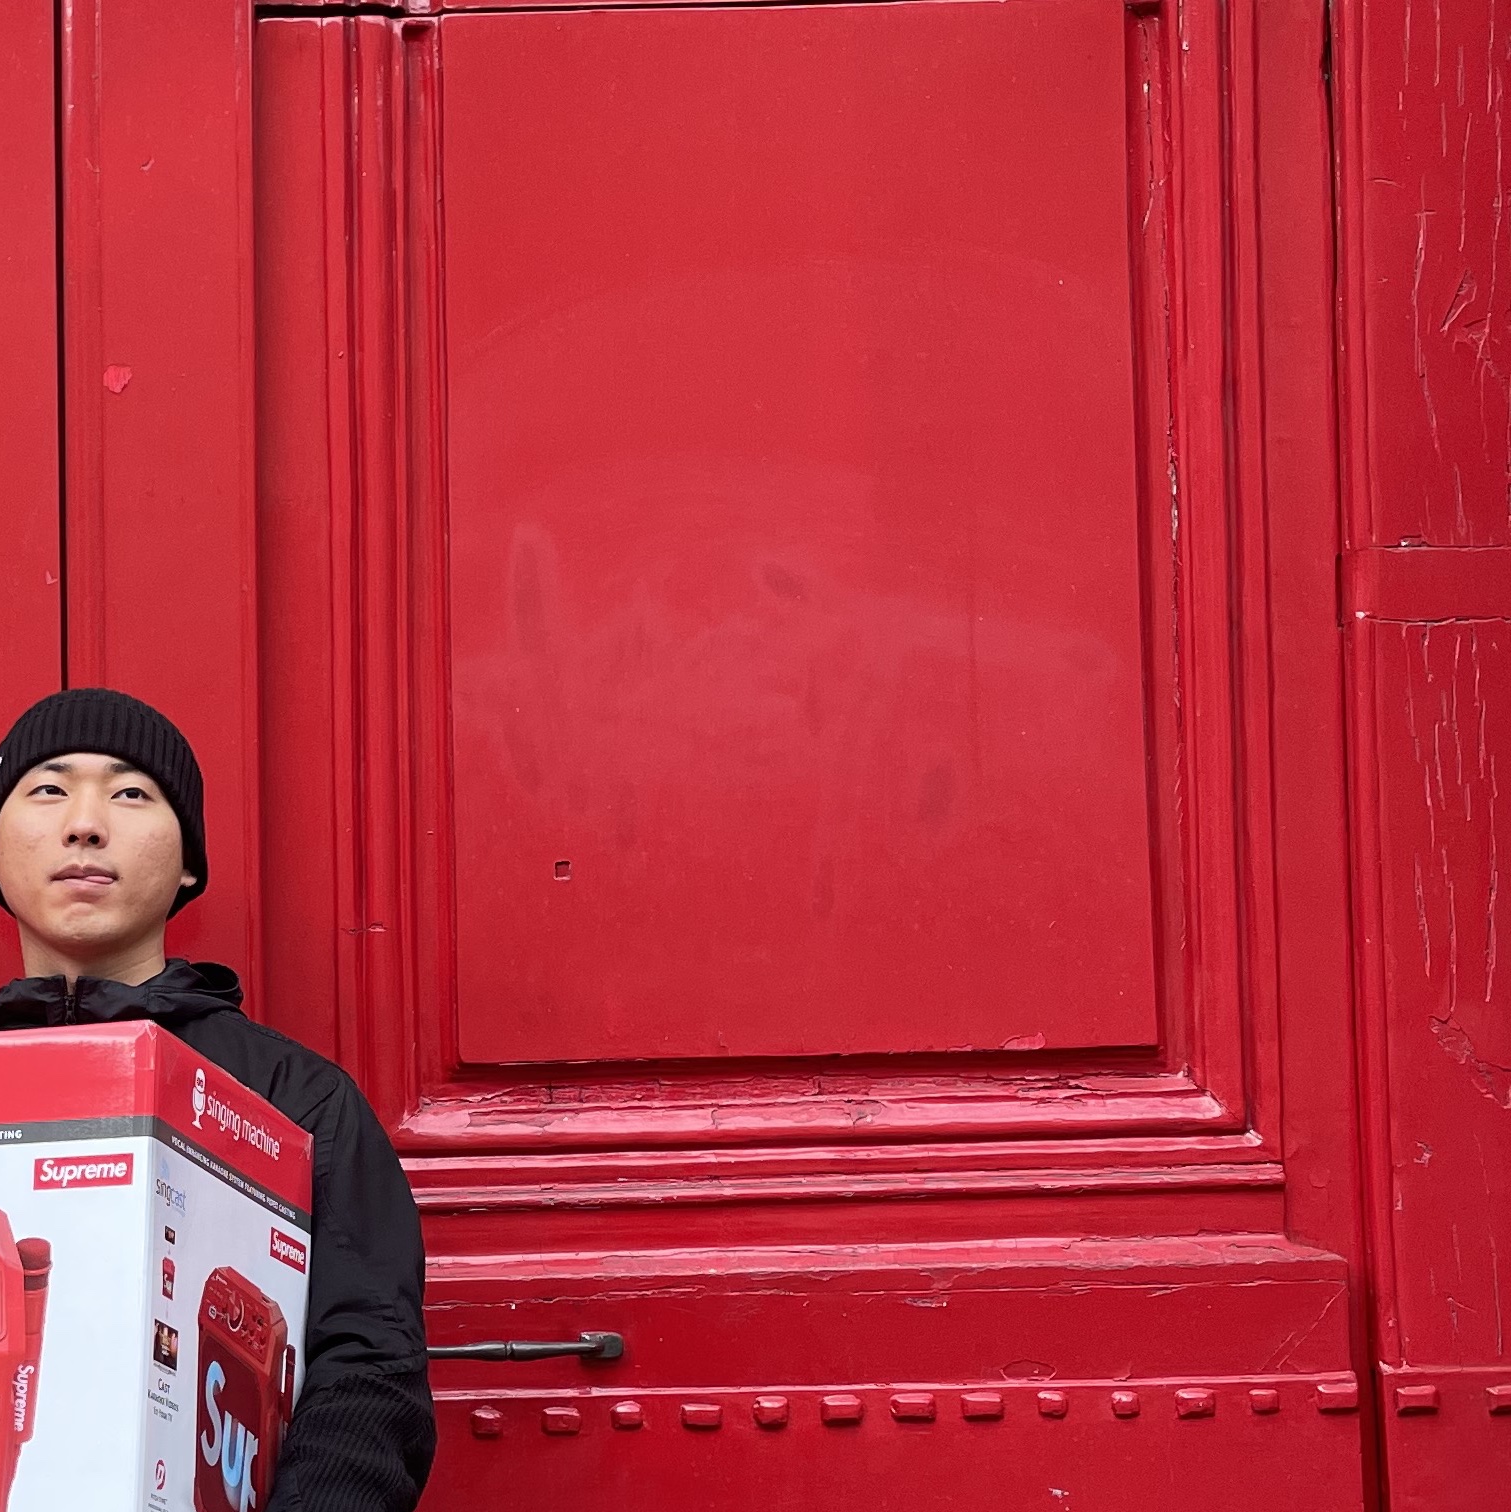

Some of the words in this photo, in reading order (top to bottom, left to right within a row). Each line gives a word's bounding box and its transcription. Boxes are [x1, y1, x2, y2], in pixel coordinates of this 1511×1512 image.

[206, 1090, 240, 1141] singing
[241, 1119, 280, 1161] machine
[38, 1159, 128, 1187] Supreme
[271, 1231, 306, 1267] Supreme
[12, 1364, 35, 1432] Supreme
